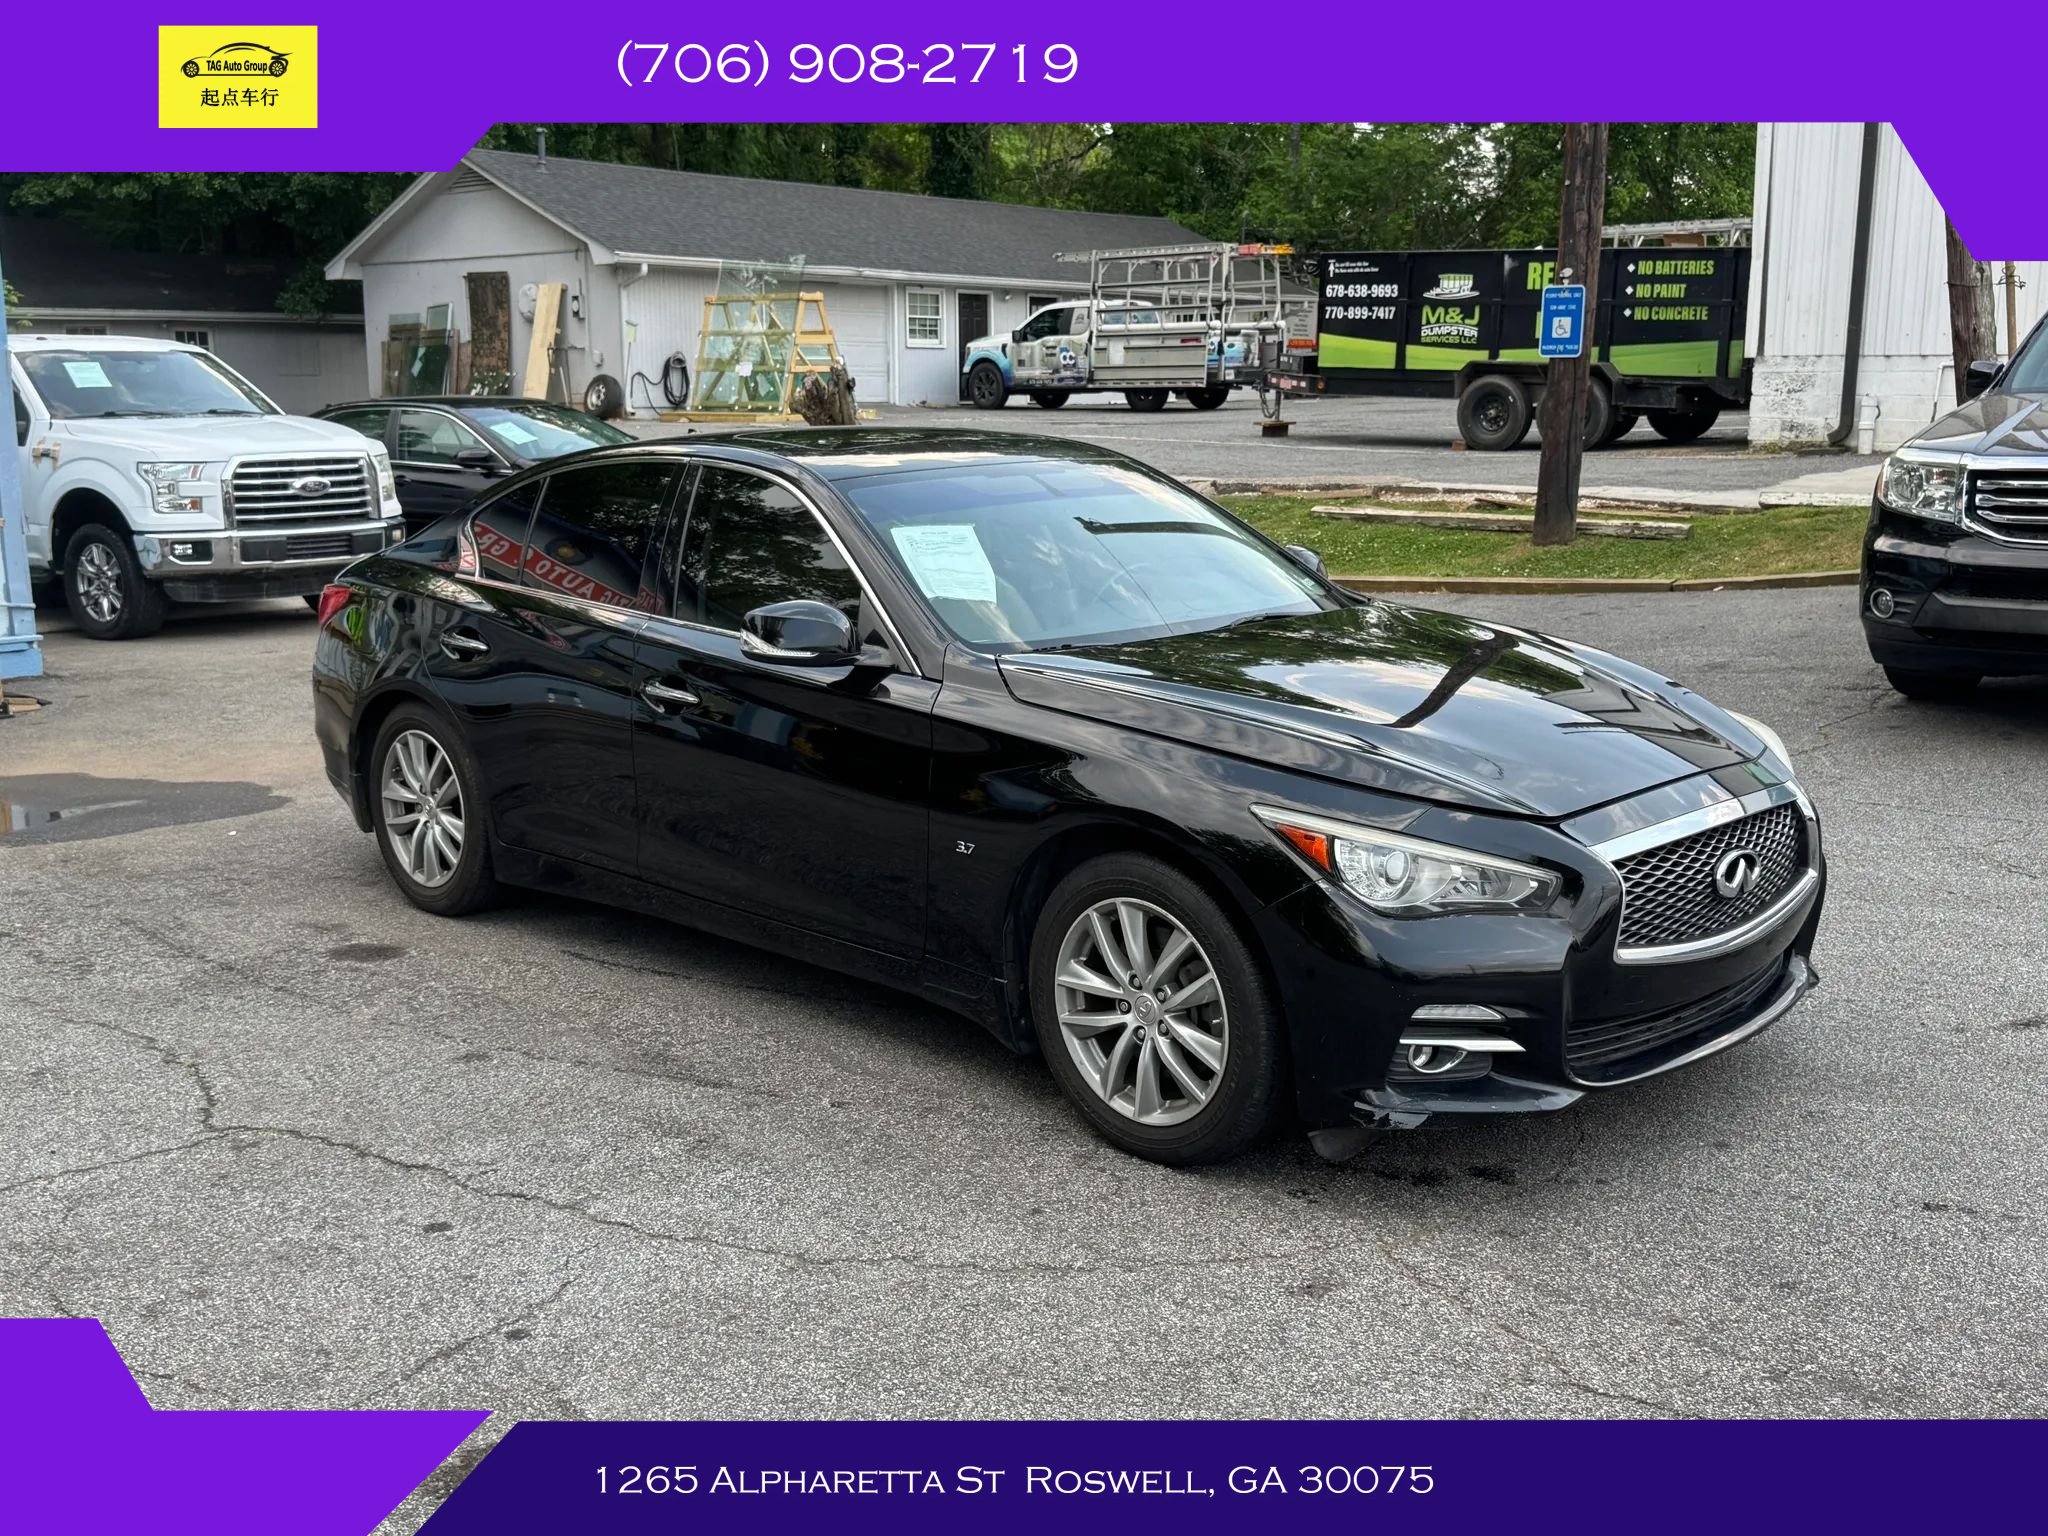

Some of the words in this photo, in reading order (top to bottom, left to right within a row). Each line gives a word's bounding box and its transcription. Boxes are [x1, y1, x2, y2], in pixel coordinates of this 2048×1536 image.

[1637, 260, 1654, 275] NO
[1655, 260, 1715, 275] BATTERIES
[1325, 283, 1399, 298] 678-638-9693
[1635, 283, 1652, 298] NO
[1653, 283, 1687, 298] PAINT
[1324, 306, 1396, 320] 770-899-7417
[1421, 304, 1480, 325] M&J
[1633, 306, 1650, 321] NO
[1651, 306, 1709, 321] CONCRETE
[1421, 326, 1478, 338] DUMPSTER
[1421, 336, 1460, 344] SERVICES
[1461, 336, 1477, 344] LLC
